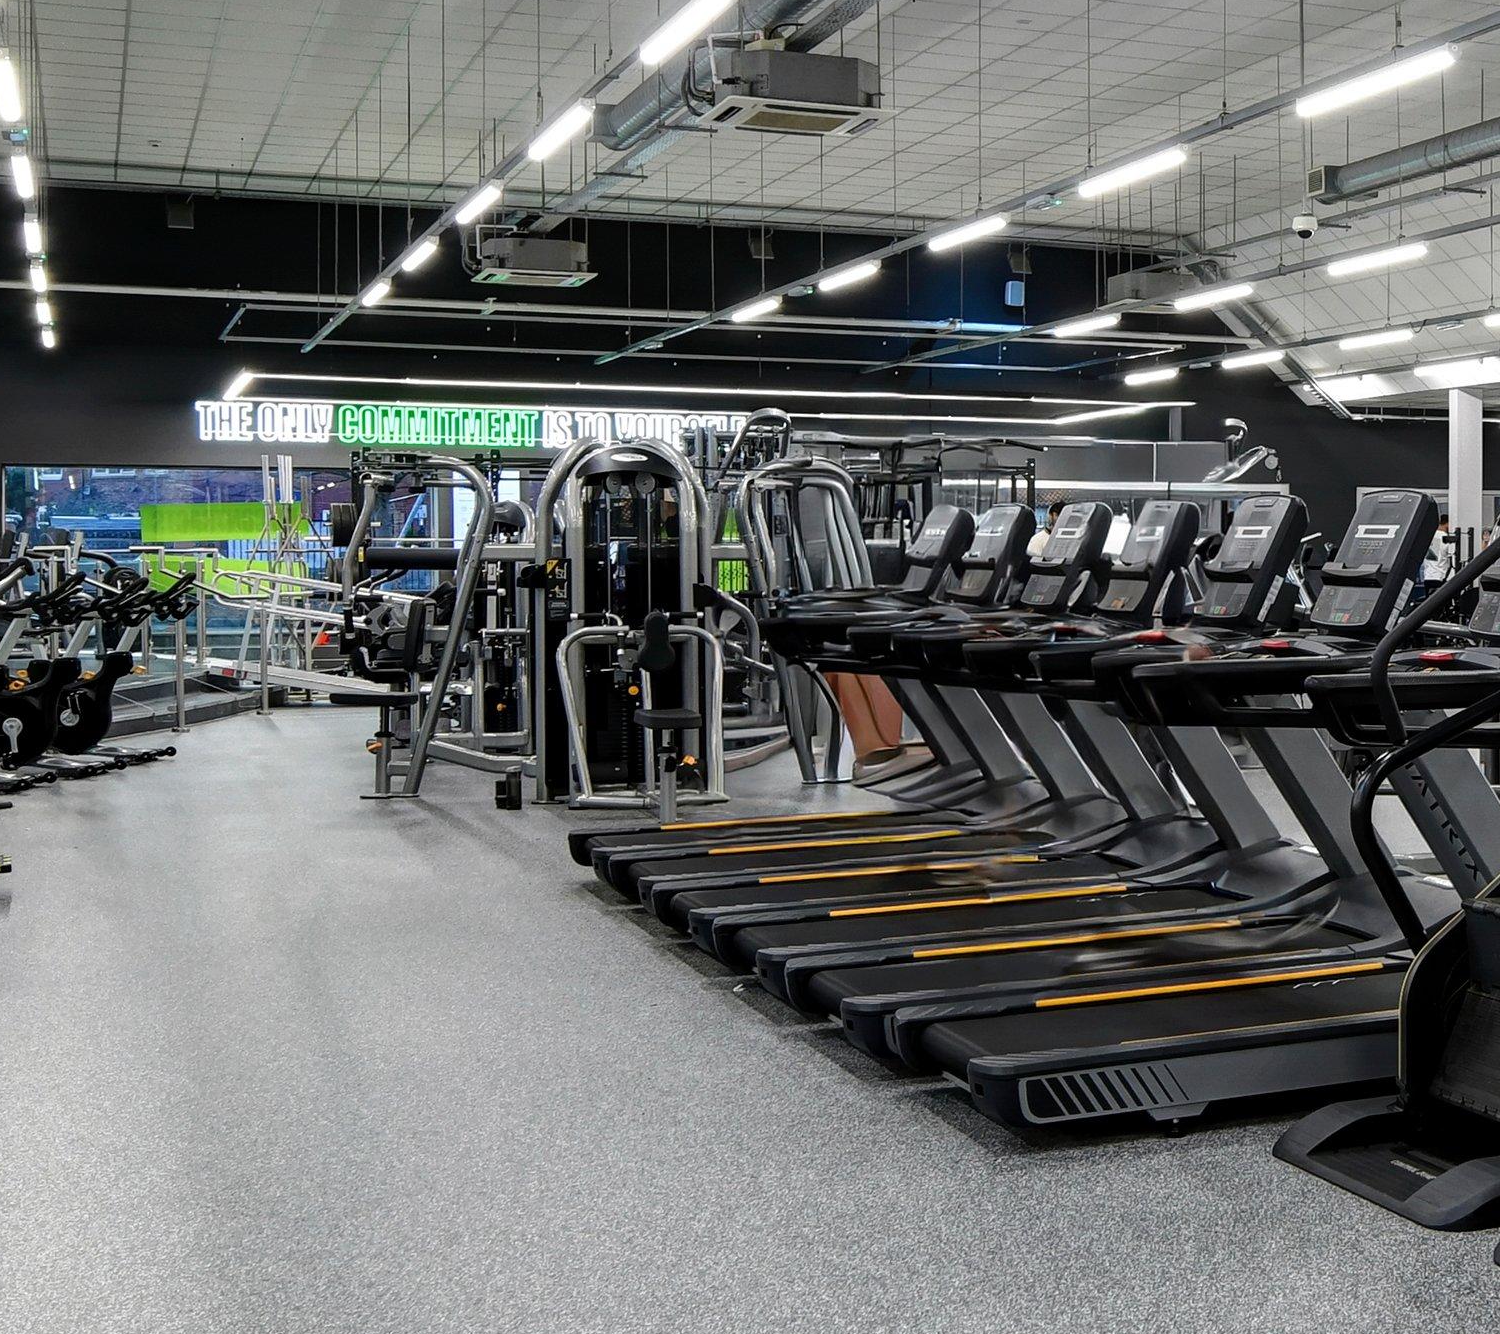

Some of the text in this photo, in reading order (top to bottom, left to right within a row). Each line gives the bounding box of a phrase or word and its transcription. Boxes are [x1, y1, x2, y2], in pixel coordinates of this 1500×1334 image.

[195, 401, 253, 441] THE
[257, 402, 334, 443] ONLY
[337, 404, 539, 446] COMMITMENT
[543, 410, 573, 448] IS
